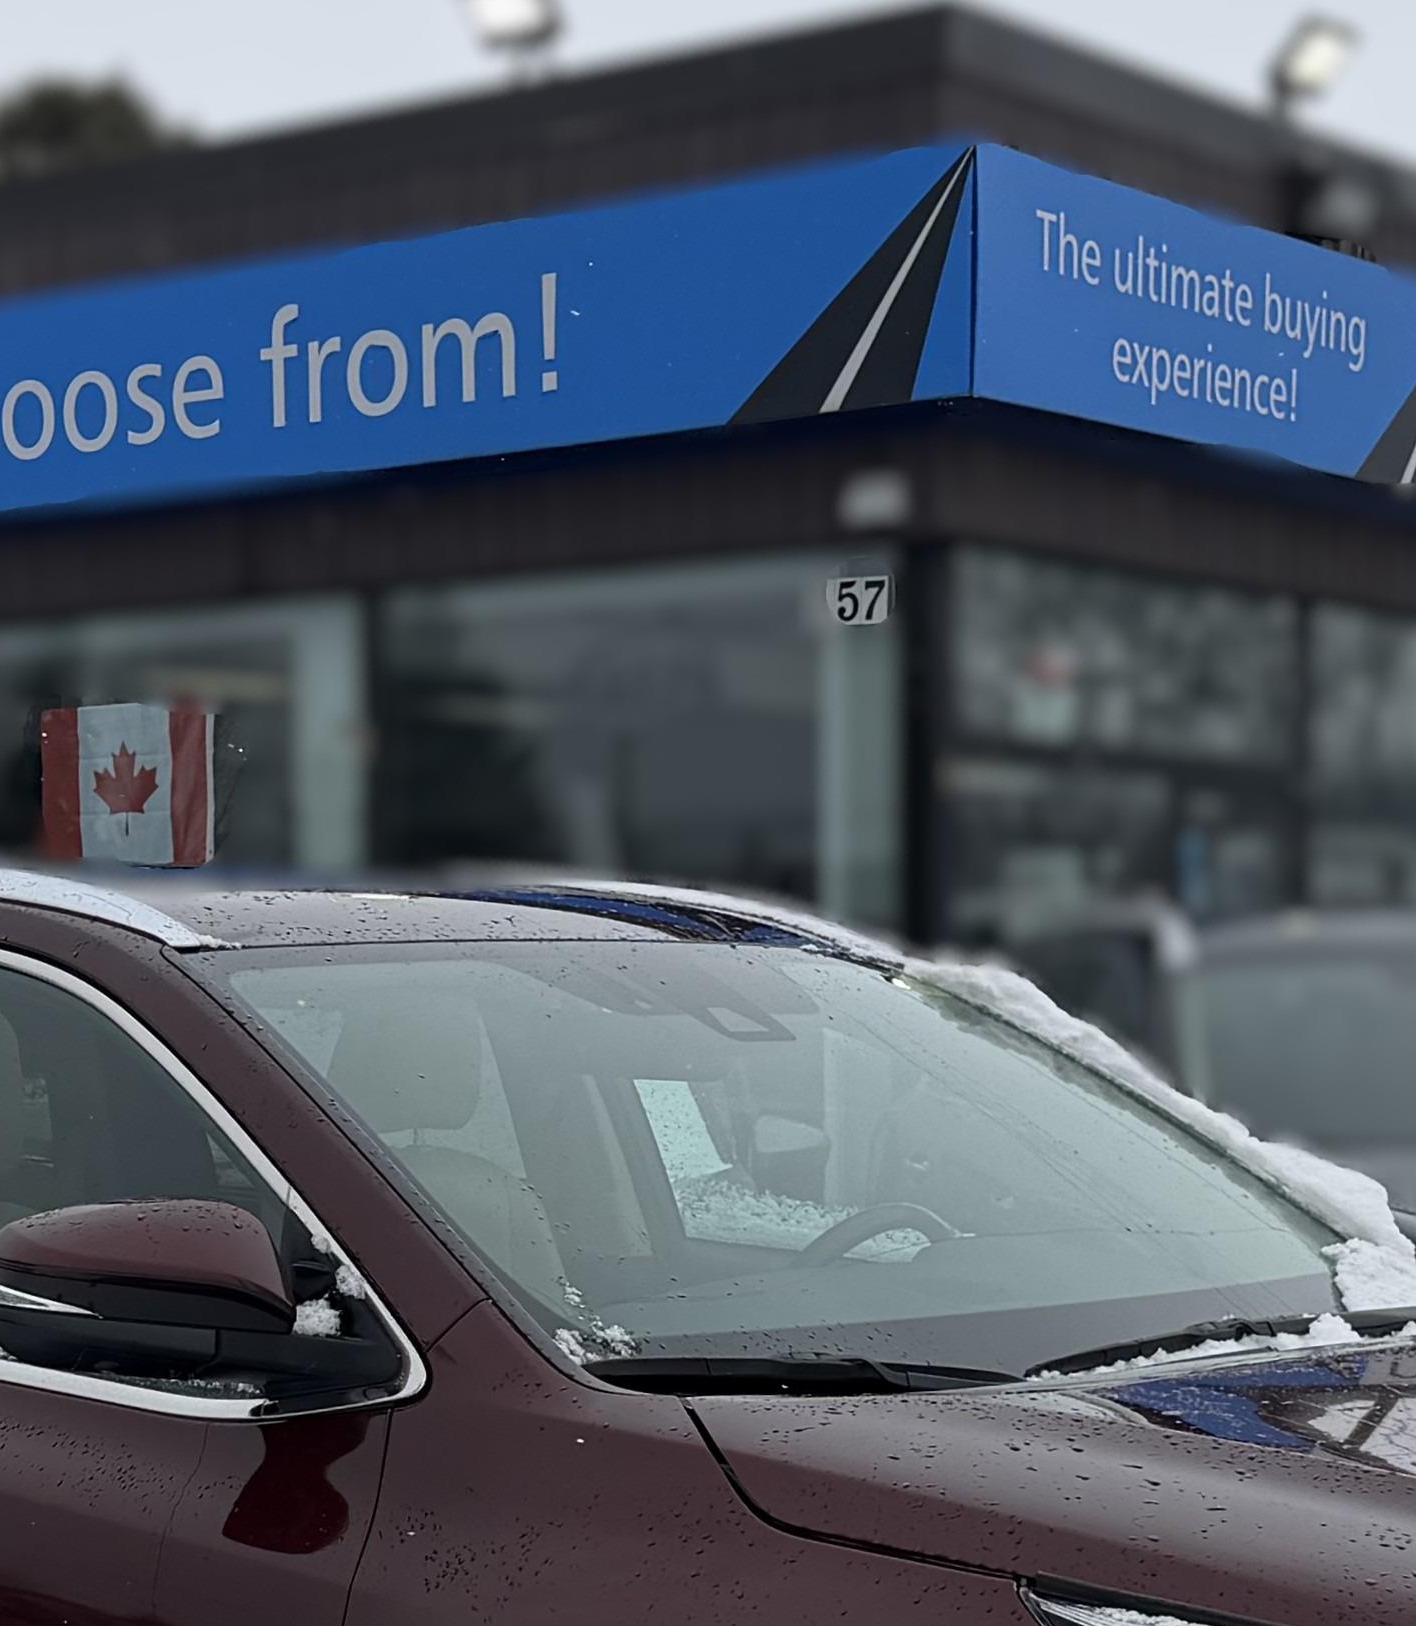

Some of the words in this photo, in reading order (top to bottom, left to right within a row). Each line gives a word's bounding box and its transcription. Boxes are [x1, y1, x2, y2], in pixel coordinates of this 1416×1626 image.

[259, 272, 559, 428] from!
[1035, 208, 1102, 286] The
[1113, 235, 1253, 327] ultimate
[1263, 272, 1367, 373] buying
[1111, 336, 1299, 423] experience!
[836, 579, 886, 622] 57
